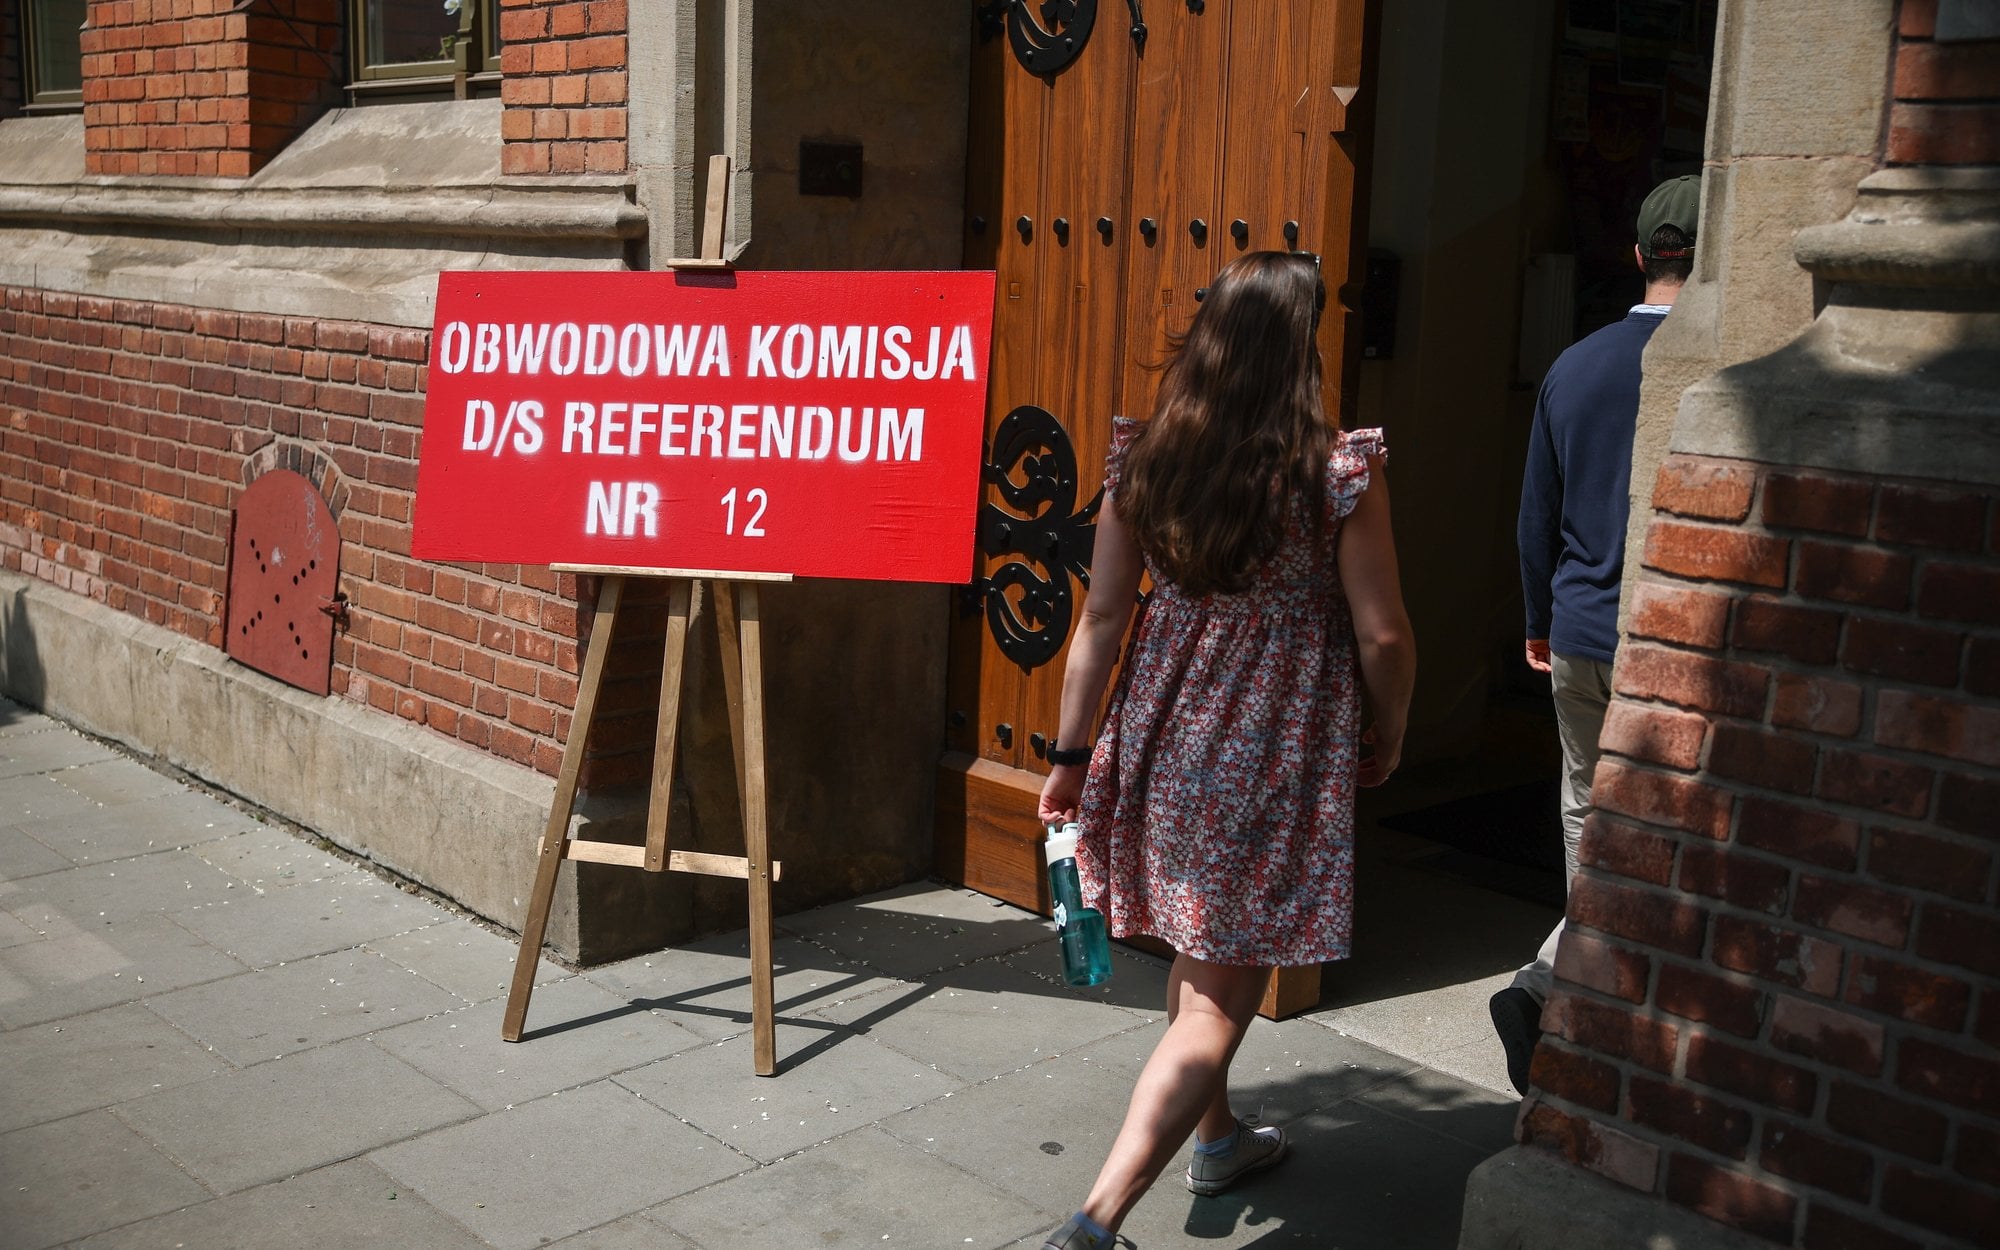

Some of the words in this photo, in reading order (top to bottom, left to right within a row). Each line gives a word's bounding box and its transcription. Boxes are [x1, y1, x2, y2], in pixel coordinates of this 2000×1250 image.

[439, 321, 731, 377] OBWODOWA
[747, 325, 976, 380] KOMISJA
[462, 400, 544, 456] D/S
[561, 401, 925, 461] REFERENDUM
[585, 481, 661, 538] NR
[720, 487, 768, 537] 12
